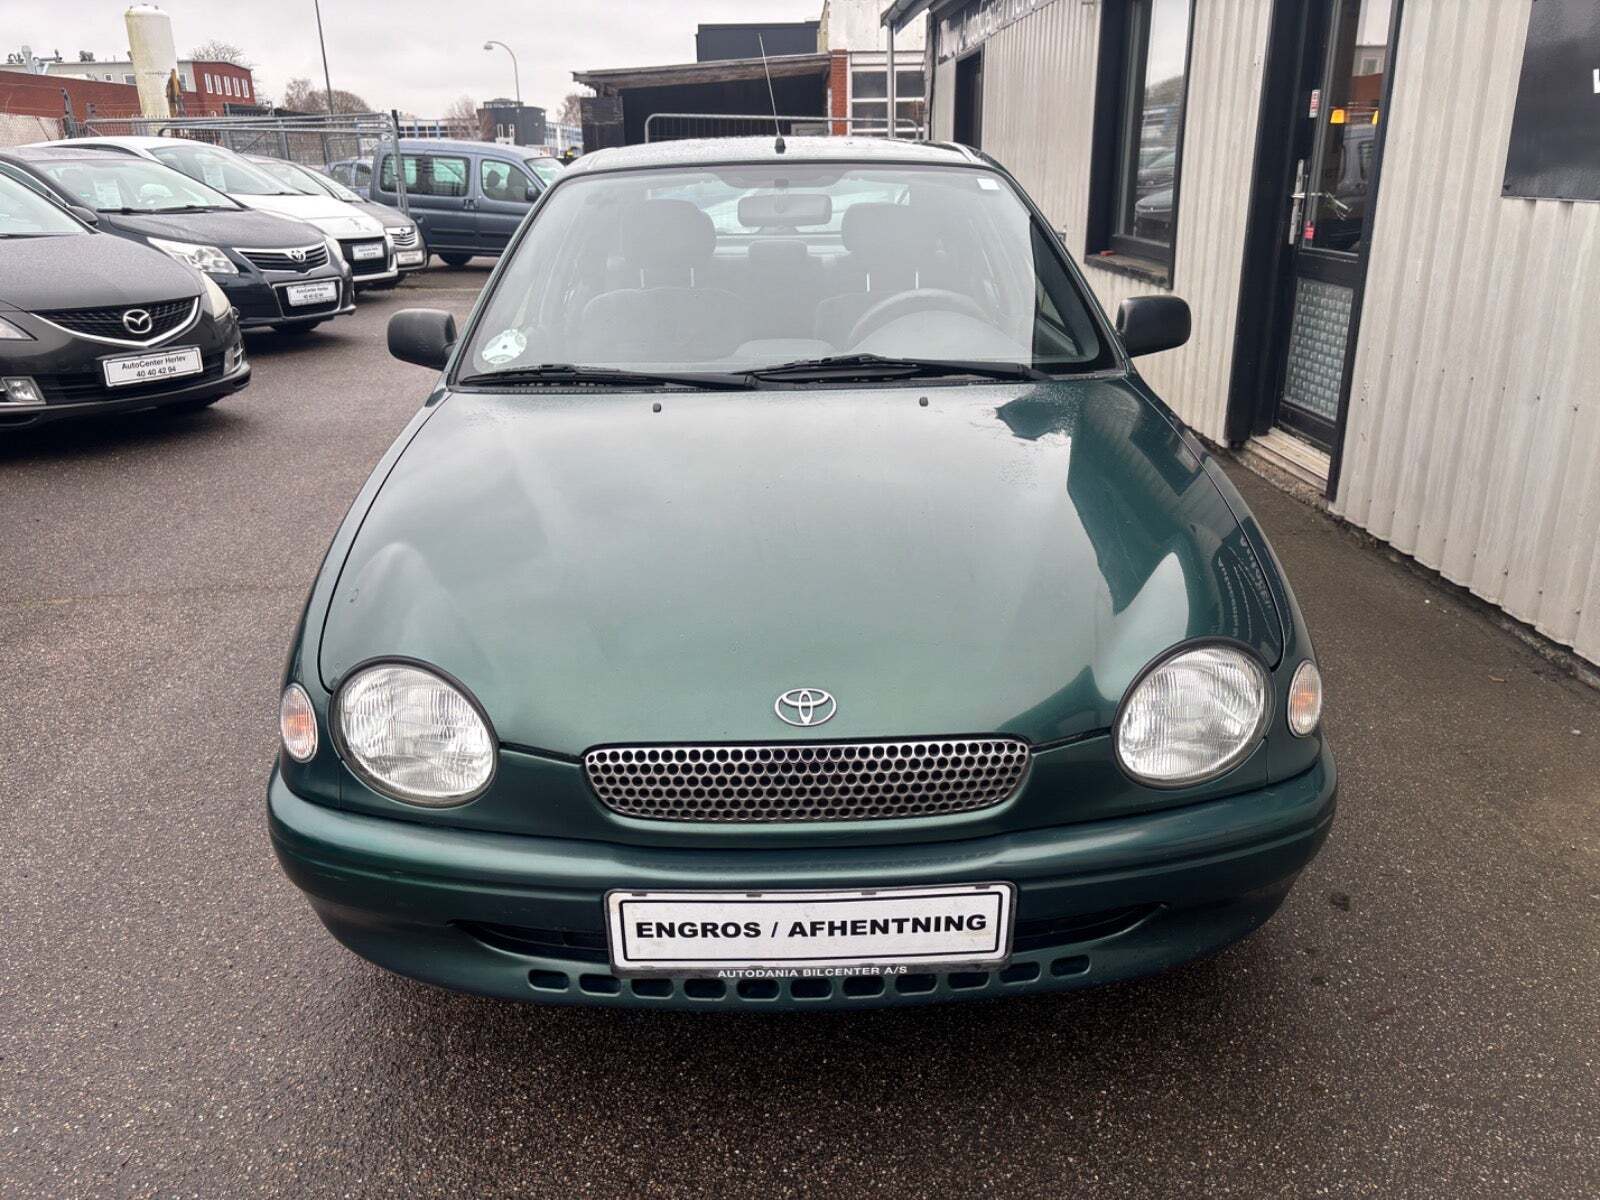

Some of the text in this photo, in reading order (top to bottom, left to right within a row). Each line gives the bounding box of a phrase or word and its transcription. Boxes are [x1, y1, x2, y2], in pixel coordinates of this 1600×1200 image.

[121, 360, 164, 370] AutoCenter
[636, 914, 987, 939] ENGROS / AFHENTNING
[717, 966, 908, 978] AUTODANIA BILCENTER A/S
